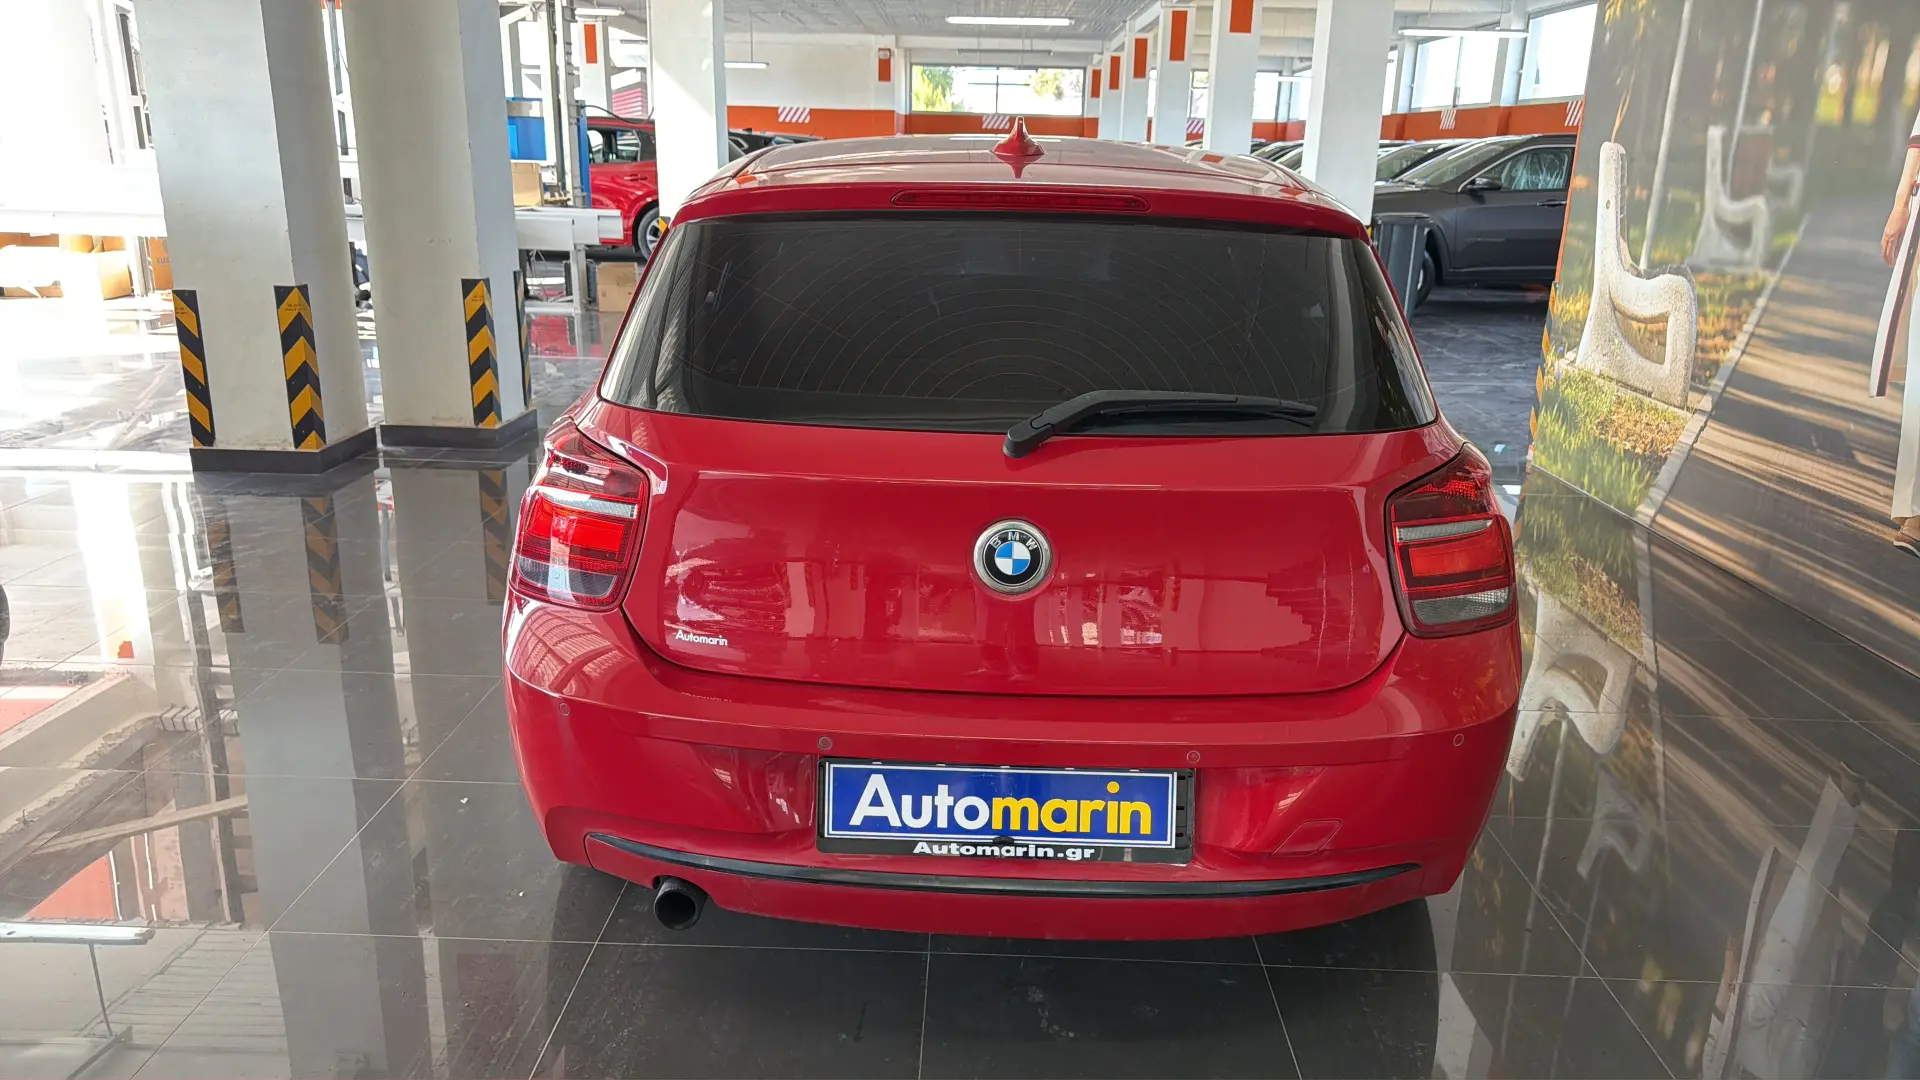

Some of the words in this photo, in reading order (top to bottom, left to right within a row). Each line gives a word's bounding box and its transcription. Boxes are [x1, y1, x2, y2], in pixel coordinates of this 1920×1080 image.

[990, 532, 1037, 550] BMW
[675, 630, 728, 646] Automarin
[849, 774, 1152, 835] Automarin
[912, 841, 1096, 861] Automarin.gr
